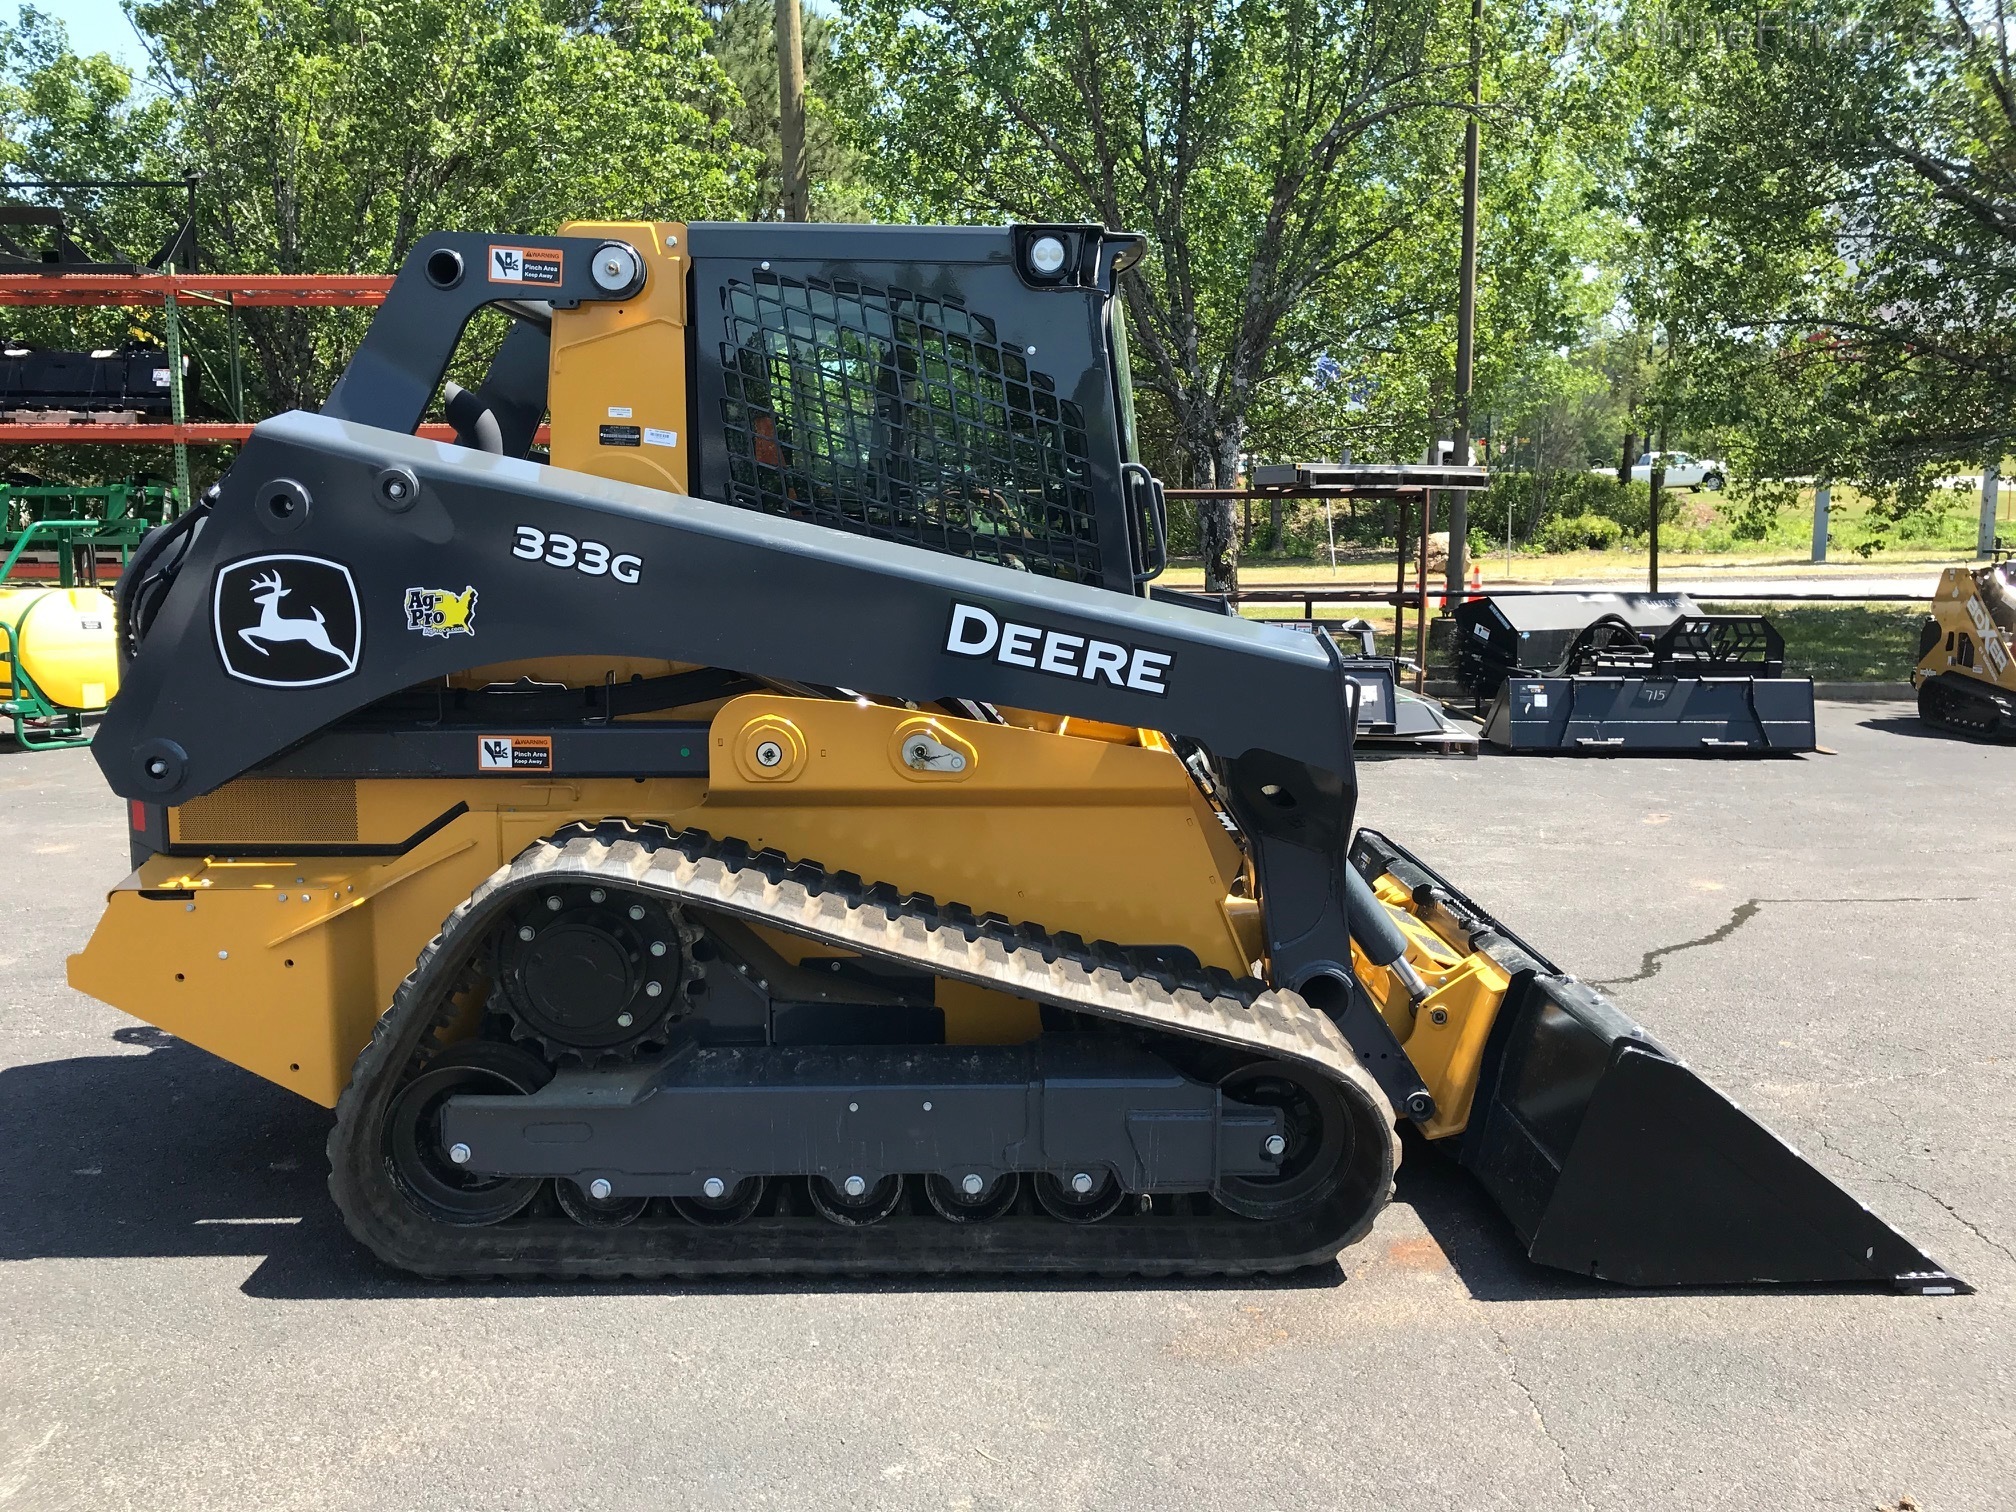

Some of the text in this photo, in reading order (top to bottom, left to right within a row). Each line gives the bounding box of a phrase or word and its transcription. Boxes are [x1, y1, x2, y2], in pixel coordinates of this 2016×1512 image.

[524, 263, 558, 272] Pinch Area
[513, 526, 642, 584] 333G
[410, 609, 445, 627] Pro
[1966, 594, 2007, 673] BOXER
[946, 603, 1172, 694] DEERE
[1645, 689, 1666, 702] 715
